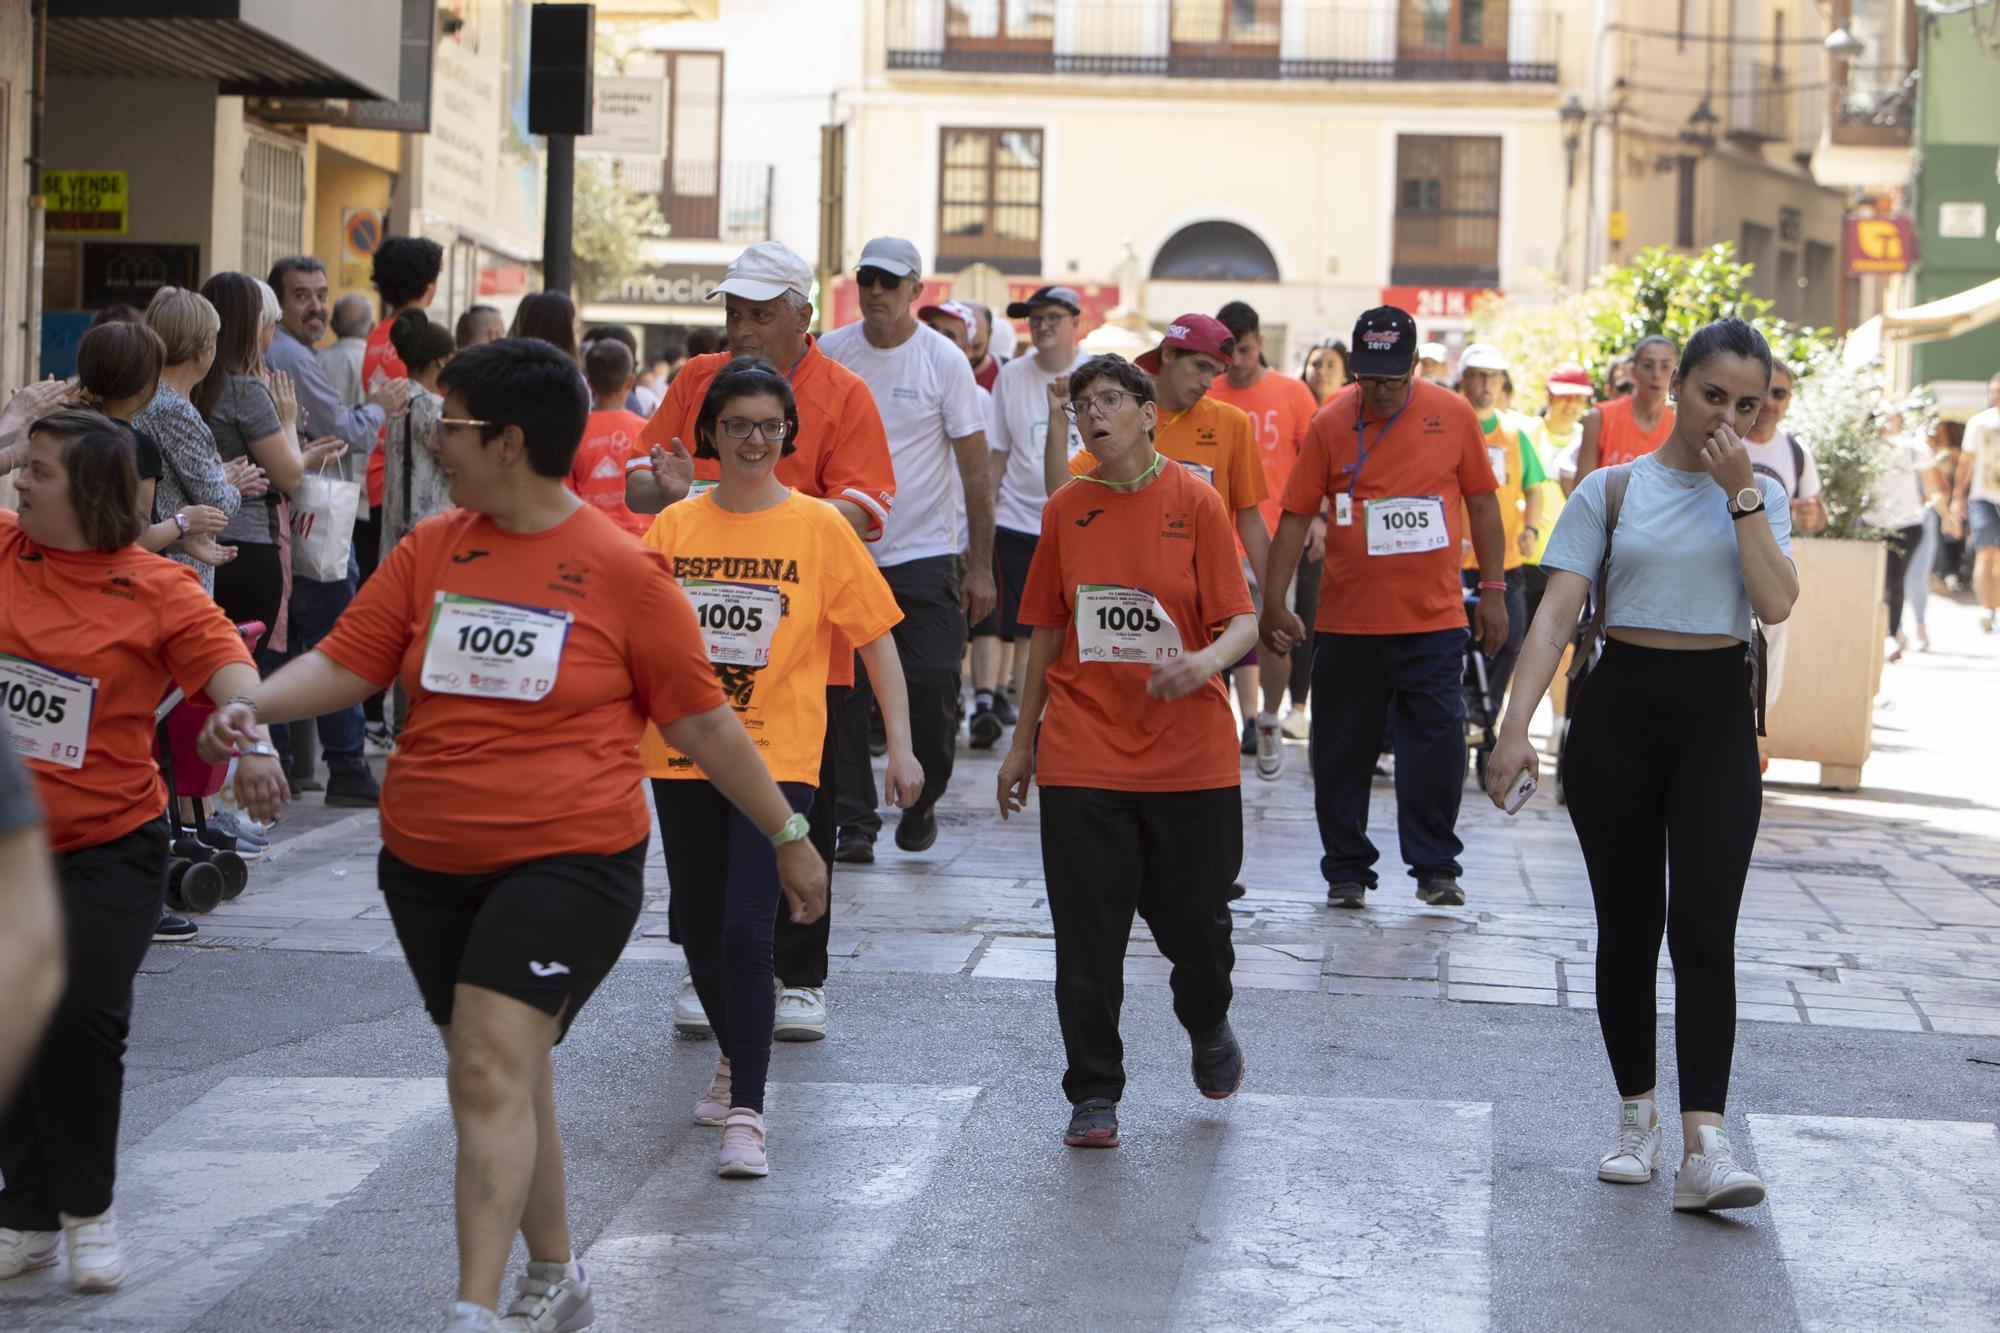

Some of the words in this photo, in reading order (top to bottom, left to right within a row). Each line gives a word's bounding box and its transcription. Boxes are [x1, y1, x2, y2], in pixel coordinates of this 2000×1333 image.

[68, 175, 120, 193] VENDE
[59, 194, 100, 208] PISO
[1417, 289, 1443, 314] 24
[1367, 341, 1391, 350] zero
[1382, 511, 1429, 530] 1005
[673, 556, 800, 584] ESPURNA
[697, 603, 763, 632] 1005
[458, 624, 538, 658] 1005
[0, 680, 67, 724] 1005
